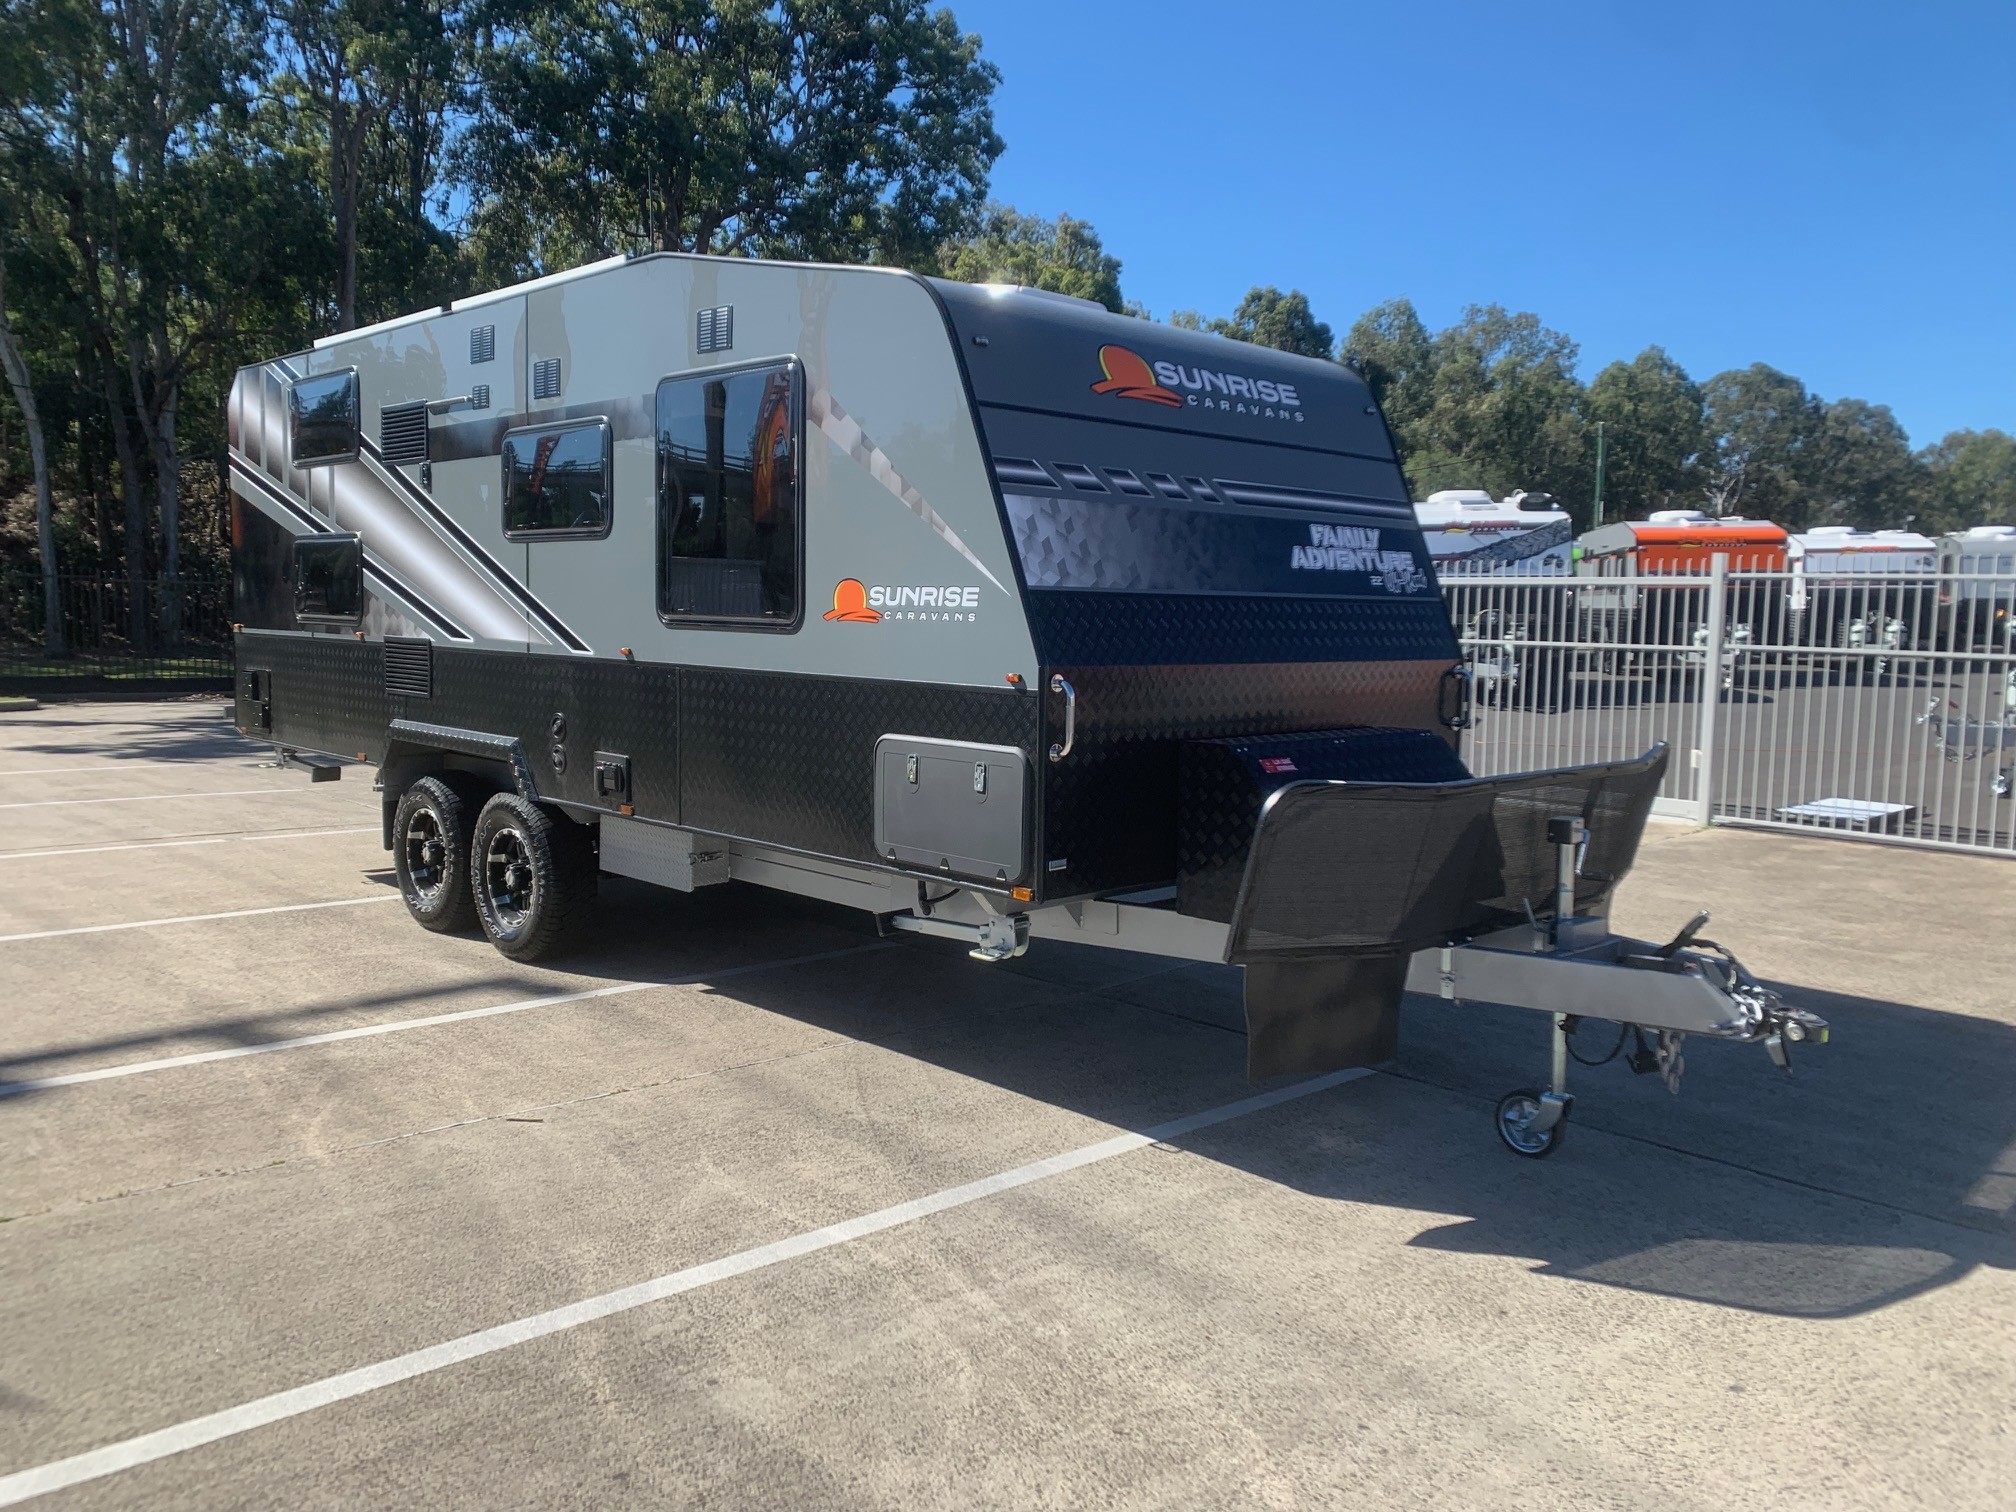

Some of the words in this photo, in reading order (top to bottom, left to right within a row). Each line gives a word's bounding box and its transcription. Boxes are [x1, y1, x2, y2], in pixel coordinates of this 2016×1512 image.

[1153, 360, 1301, 405] SUNRISE
[1186, 394, 1305, 423] CARAVANS
[1309, 523, 1380, 549] FAMILY
[1291, 545, 1415, 572] ADVENTURE
[869, 585, 980, 607] SUNRISE
[884, 611, 976, 622] CARAVANS
